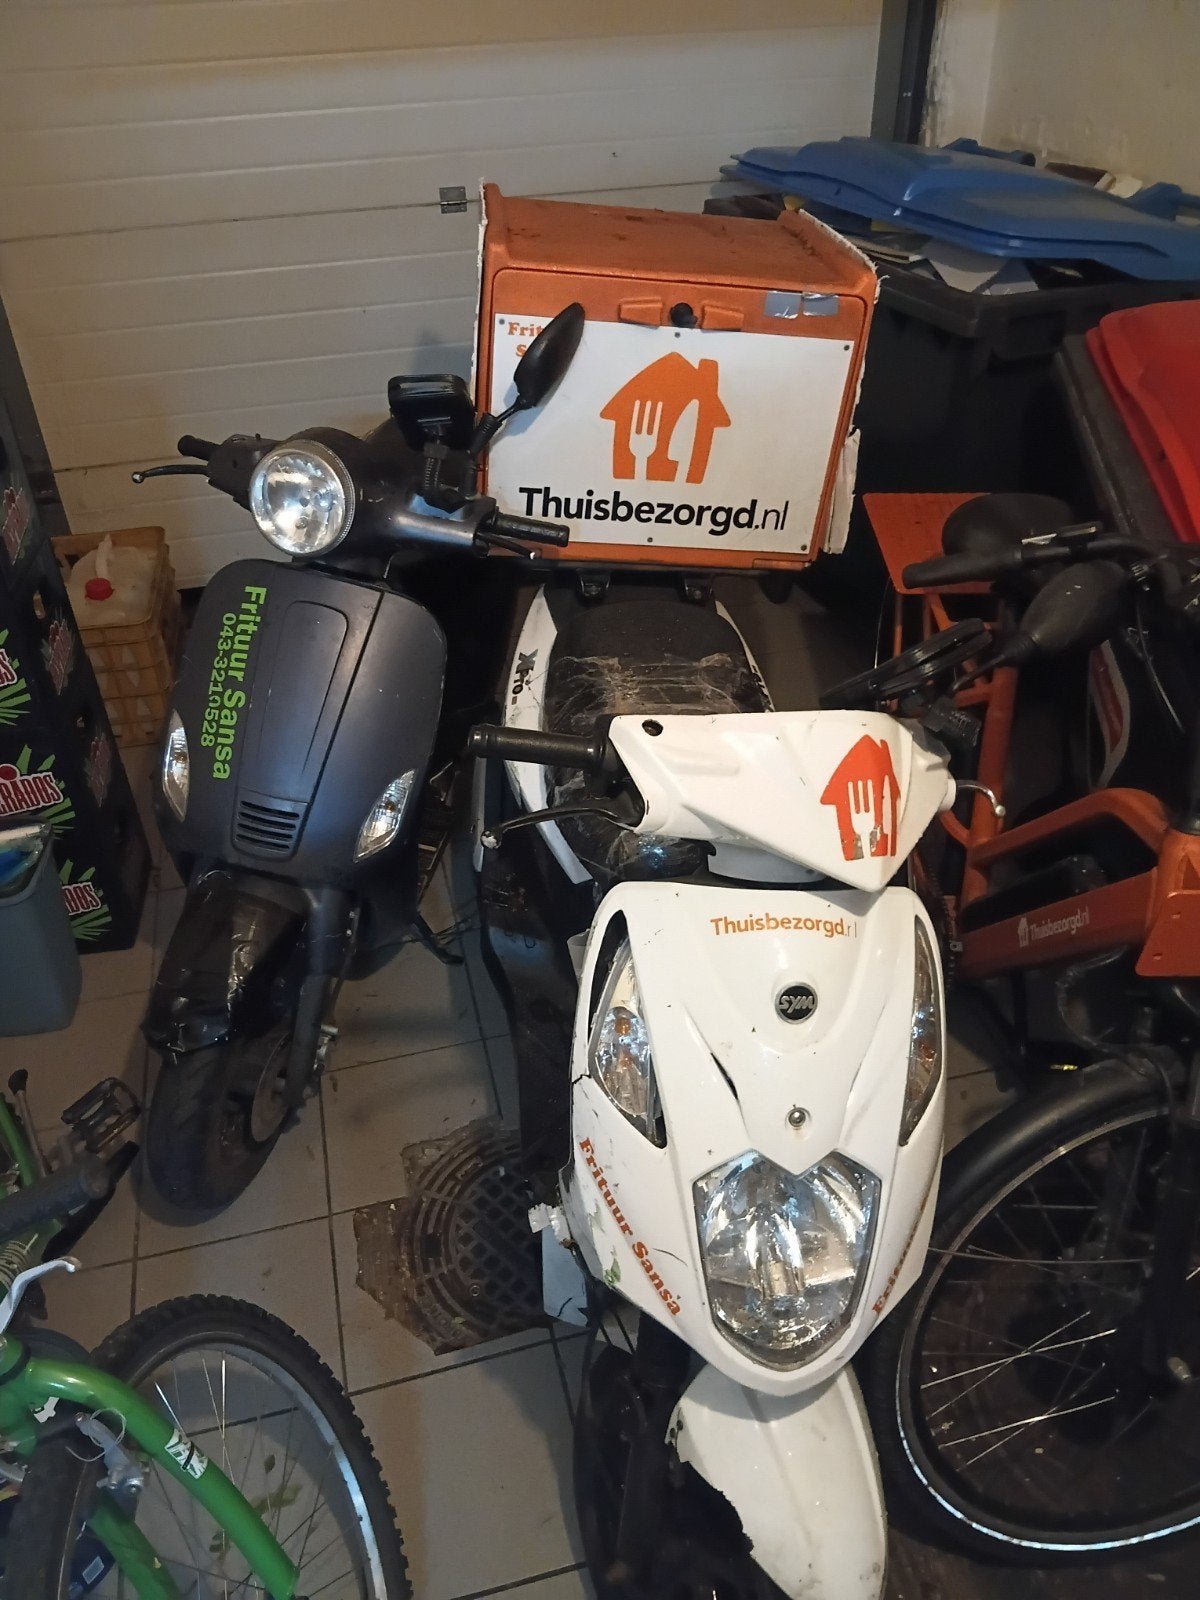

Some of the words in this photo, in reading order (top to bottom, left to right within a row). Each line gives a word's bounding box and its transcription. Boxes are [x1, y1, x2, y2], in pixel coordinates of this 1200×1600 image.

[508, 321, 545, 337] Frit
[518, 486, 790, 536] Thuisbezorgd.nl
[227, 585, 268, 682] Frituur
[200, 612, 237, 748] 043-3210528
[212, 688, 246, 780] Sansa
[779, 995, 814, 1013] SYM
[579, 1136, 634, 1236] Frituur
[632, 1241, 681, 1316] Sansa
